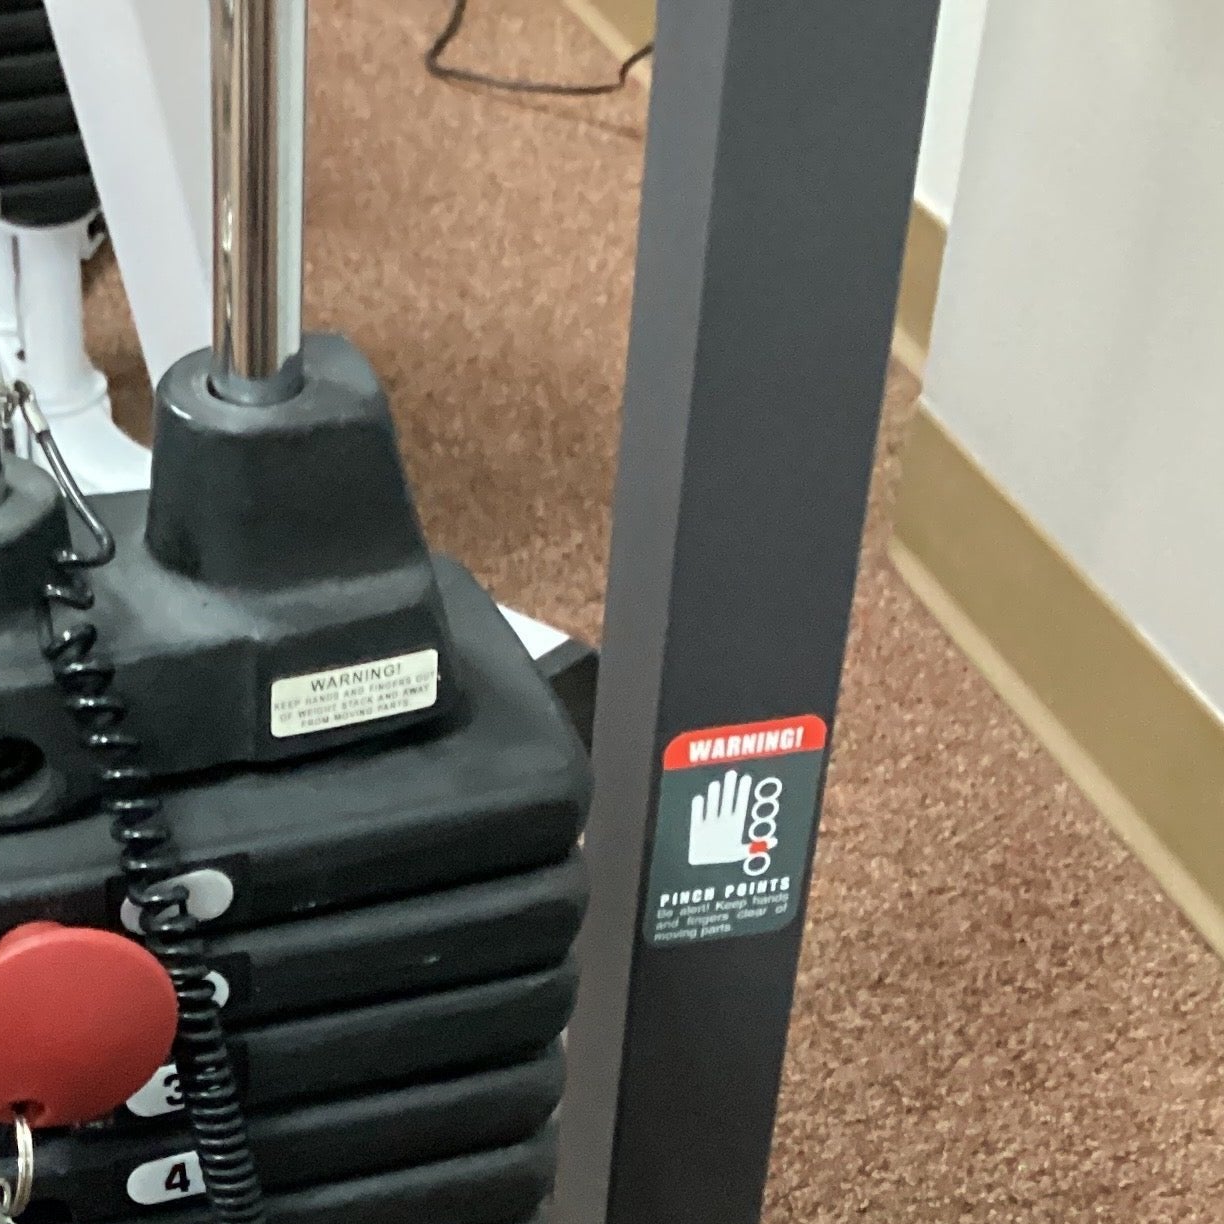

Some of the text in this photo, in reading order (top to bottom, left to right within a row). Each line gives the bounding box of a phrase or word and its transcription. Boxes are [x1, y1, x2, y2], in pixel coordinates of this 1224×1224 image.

[310, 662, 402, 693] WARNING!
[341, 696, 373, 710] STACK
[377, 690, 399, 702] AND
[403, 683, 430, 697] AWAY
[343, 686, 364, 698] AND
[301, 715, 330, 728] FROM
[334, 706, 373, 721] MOVING
[689, 726, 804, 763] WARNING!
[659, 876, 791, 908] PINCH POINTS
[715, 899, 748, 912] Keep
[752, 893, 789, 906] hands
[655, 903, 788, 931] and fingers clear of
[653, 928, 698, 943] moving
[165, 1162, 191, 1192] 4
